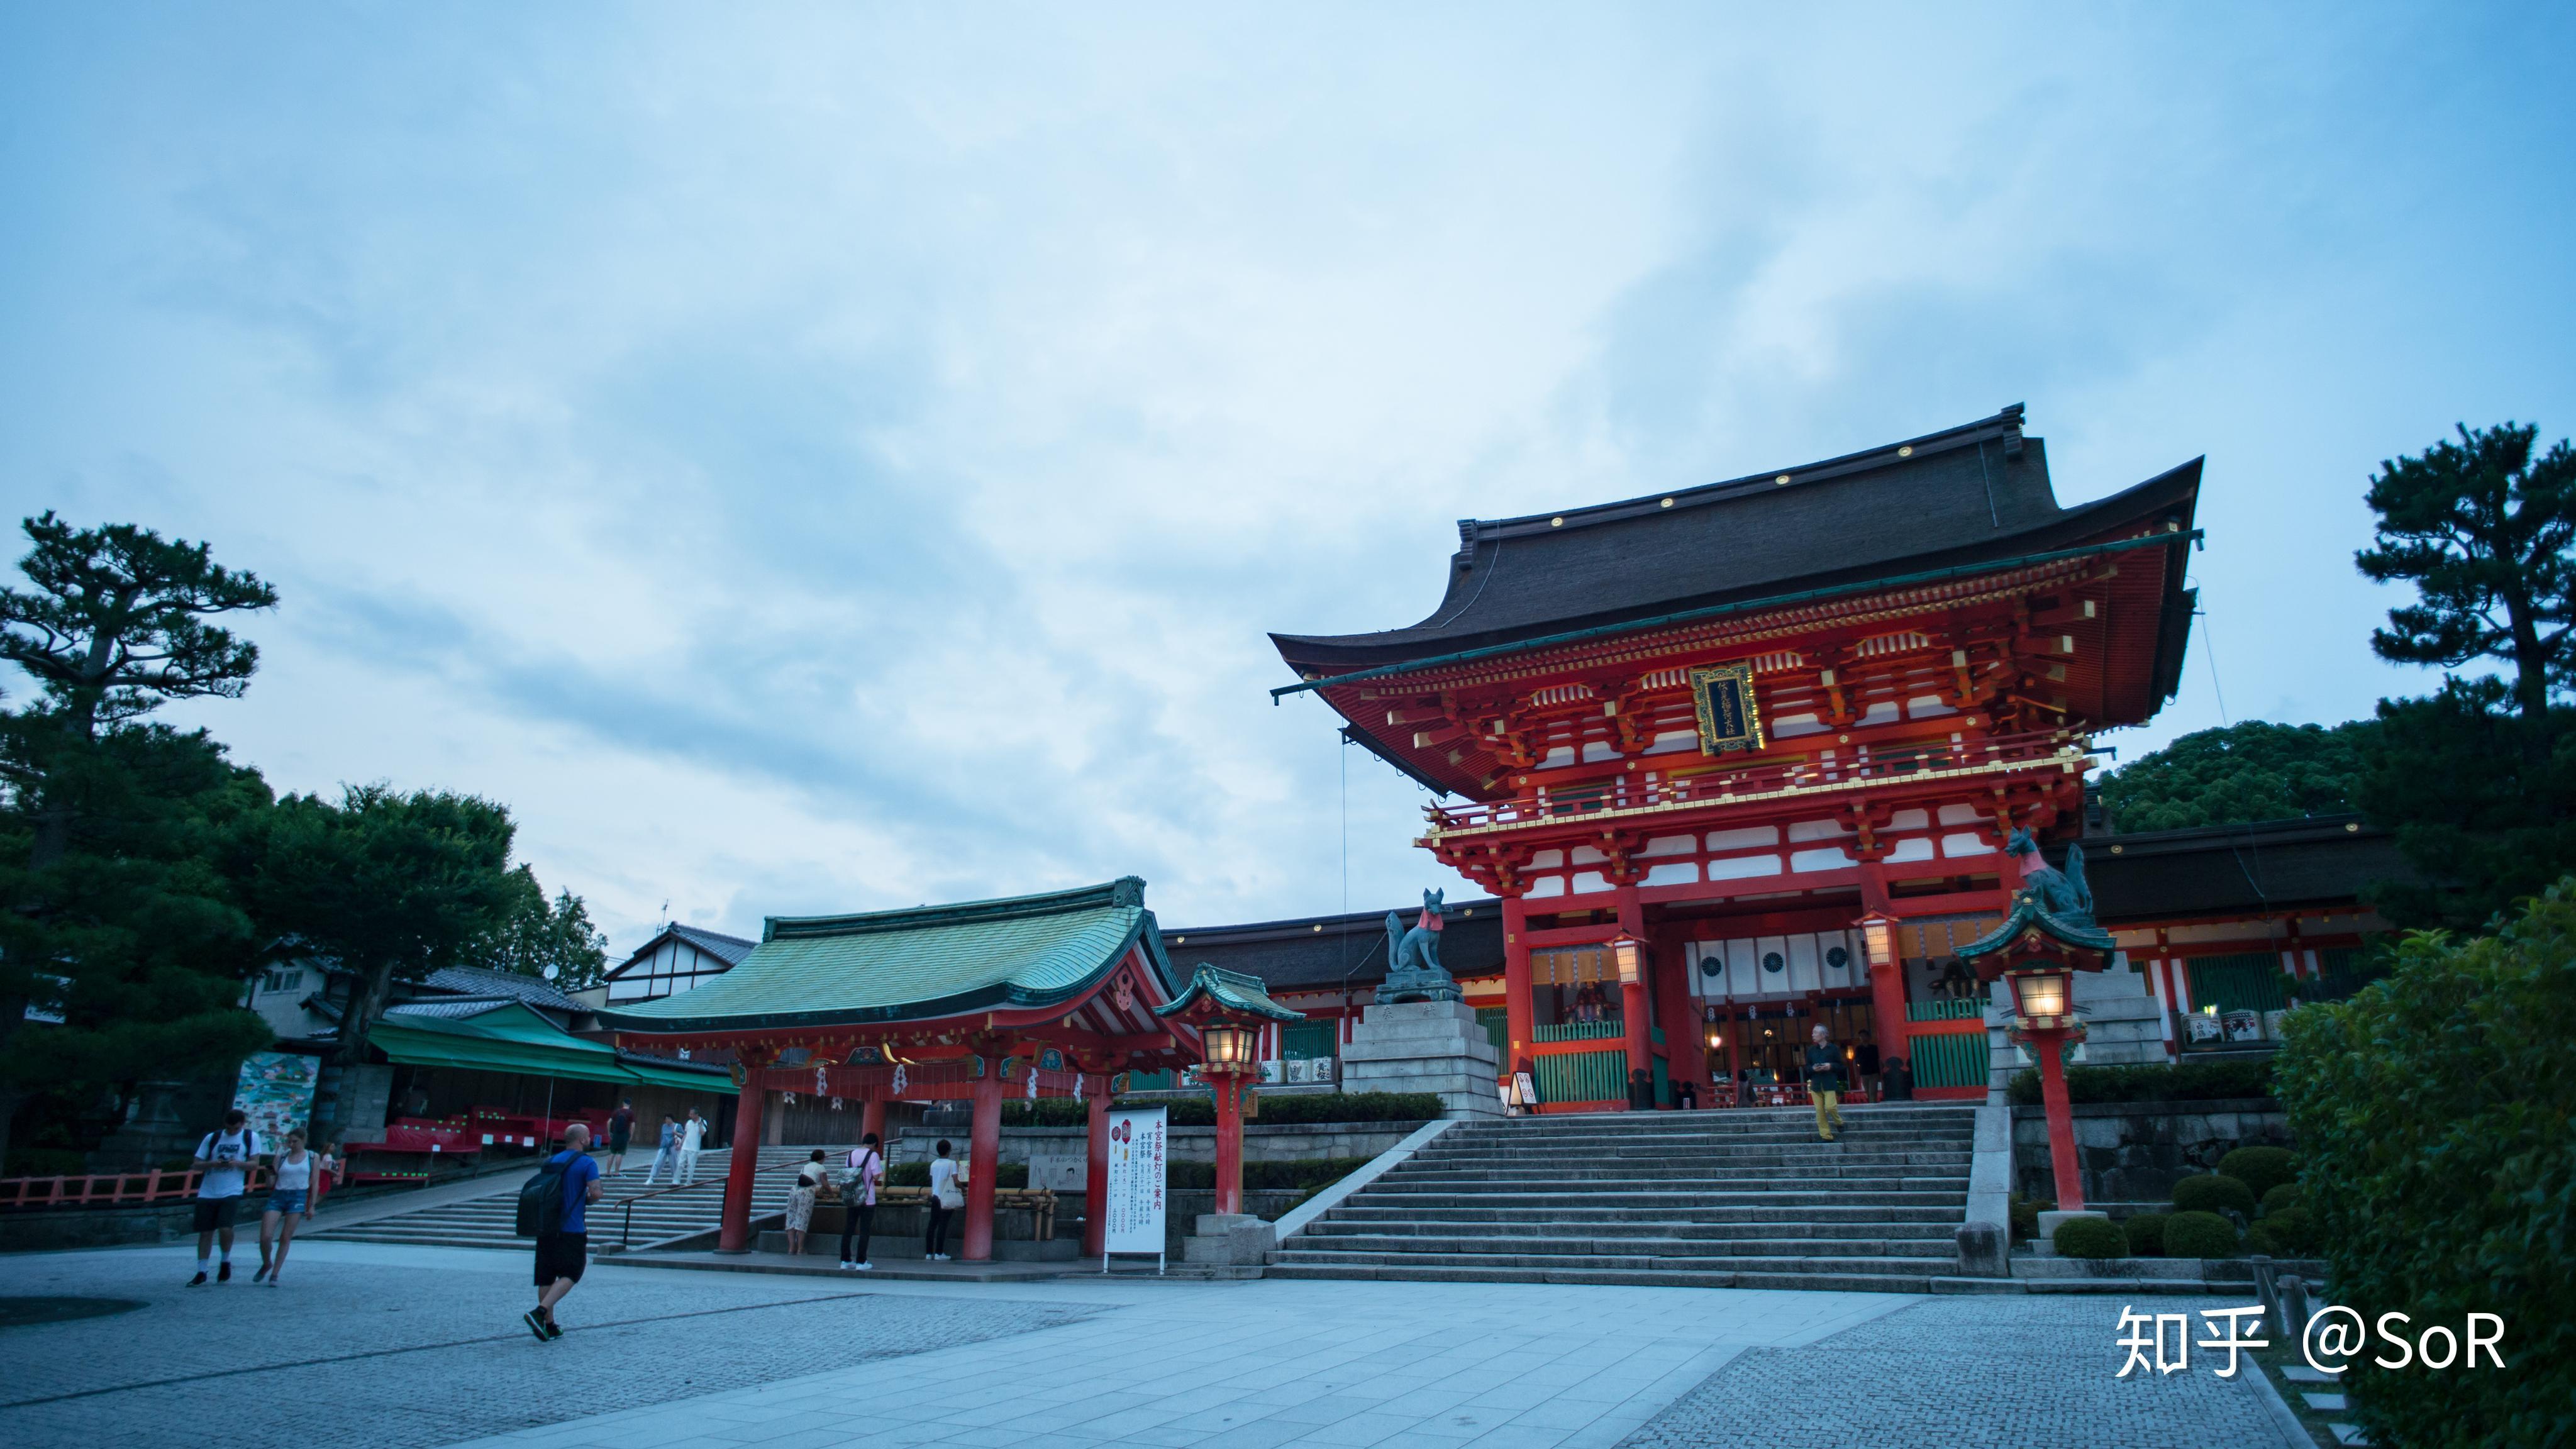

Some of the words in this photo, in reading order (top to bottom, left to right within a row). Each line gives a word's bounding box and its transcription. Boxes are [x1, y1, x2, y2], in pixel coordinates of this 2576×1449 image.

[1153, 1119, 1163, 1210] 本宮祭献灯のご案内
